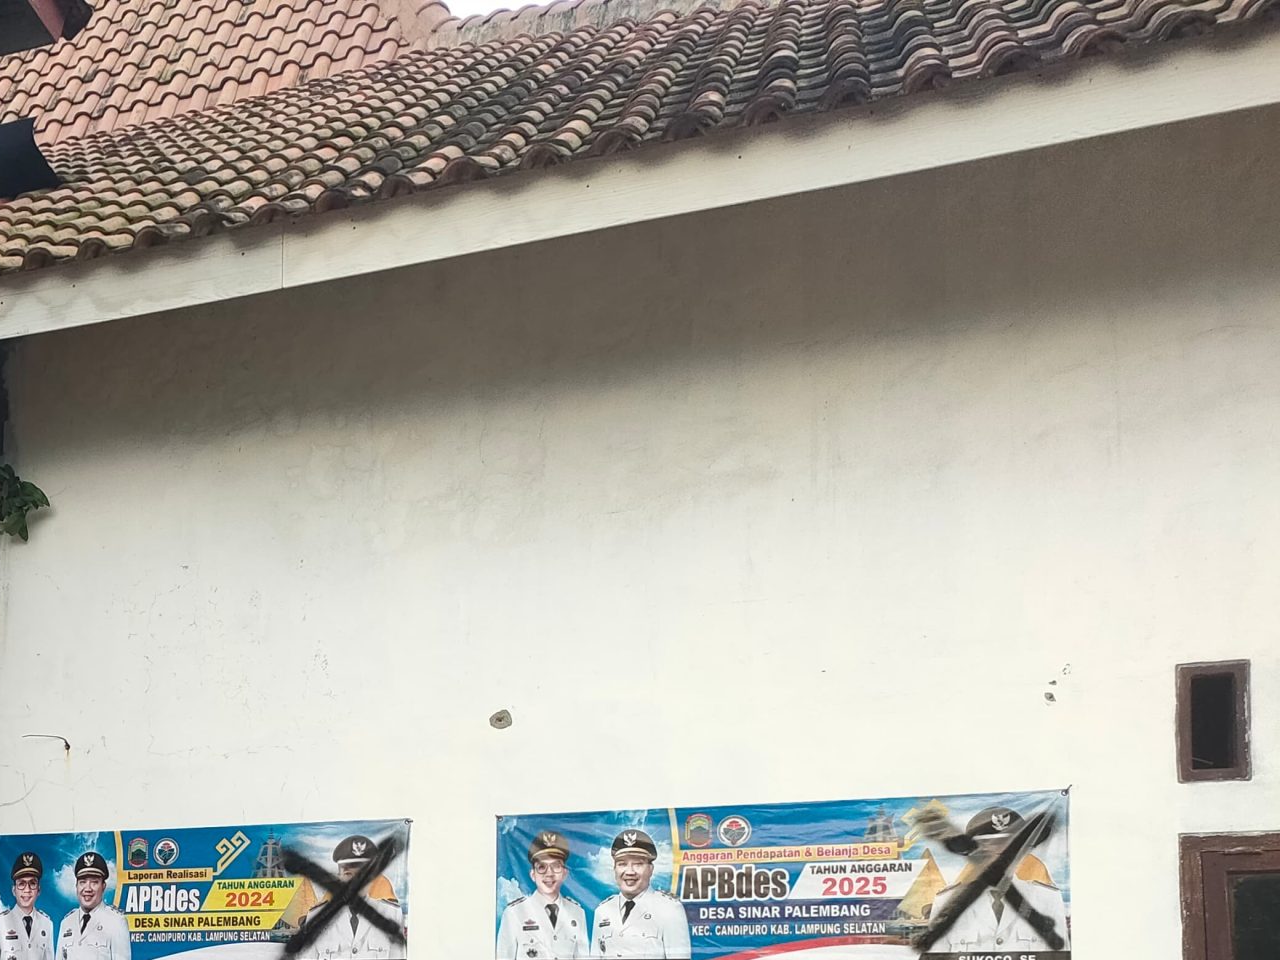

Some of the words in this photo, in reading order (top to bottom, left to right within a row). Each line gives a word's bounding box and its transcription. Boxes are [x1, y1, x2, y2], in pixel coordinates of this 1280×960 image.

[682, 850, 732, 862] Anggaran
[736, 848, 800, 861] Pendapatan
[804, 847, 812, 857] &
[816, 846, 859, 858] Belanja
[862, 845, 891, 856] Desa
[127, 871, 164, 881] Laporan
[166, 869, 207, 880] Realisasi
[810, 864, 846, 875] TAHUN
[850, 863, 912, 874] ANGGARAN
[217, 881, 245, 890] TAHUN
[249, 880, 295, 888] ANGGARAN
[682, 866, 789, 900] APBdes
[822, 876, 888, 896] 2025
[125, 885, 201, 912] APBdes
[225, 891, 275, 908] 2024
[700, 907, 734, 920] DESA
[738, 906, 780, 919] SINAR
[785, 904, 871, 918] PALEMBANG
[134, 917, 160, 928] DESA
[164, 916, 194, 928] SINAR
[197, 916, 261, 927] PALEMBANG
[692, 925, 712, 936] KEC.
[715, 924, 768, 936] CANDIPURO
[770, 924, 792, 935] KAB.
[794, 923, 841, 935] LAMPUNG
[843, 922, 886, 934] SELATAN
[130, 933, 146, 942] KEC.
[148, 932, 186, 942] CANDIPURO
[188, 932, 204, 942] KAB.
[205, 932, 238, 942] LAMPUNG
[239, 930, 270, 941] SELATAN
